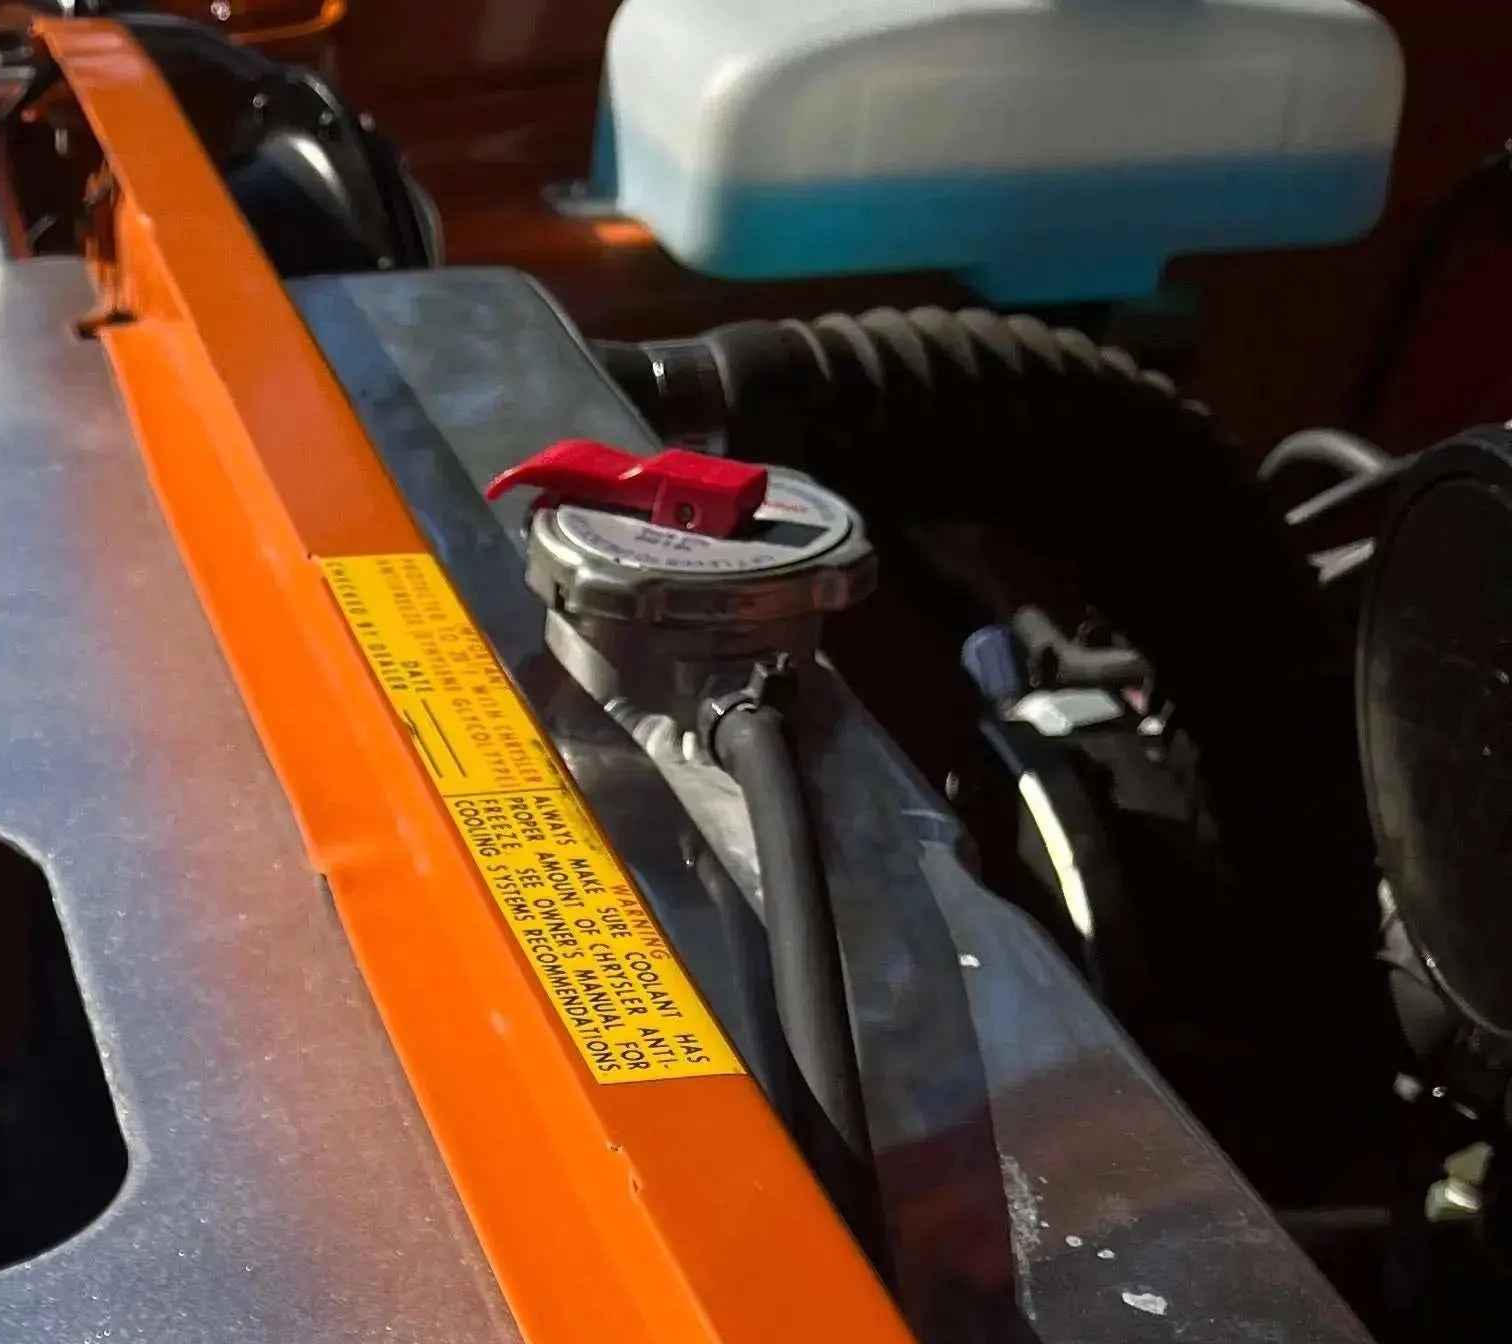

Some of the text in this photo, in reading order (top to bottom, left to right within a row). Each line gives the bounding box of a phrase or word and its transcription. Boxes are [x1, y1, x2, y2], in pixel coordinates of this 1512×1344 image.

[401, 661, 433, 692] DATE
[454, 801, 499, 855] COOLING
[489, 866, 533, 919] SYSTEMS
[505, 797, 678, 1068] PROPER AMOUNT OF CHRYSLER ANTI-
[532, 796, 710, 1063] ALWAYS MAKE SURE COOLANT HAS
[611, 885, 668, 959] WARNING
[516, 869, 542, 887] SEE
[534, 899, 583, 958] OWNER'S
[575, 970, 624, 1028] MANUAL
[616, 1042, 648, 1068] FOR
